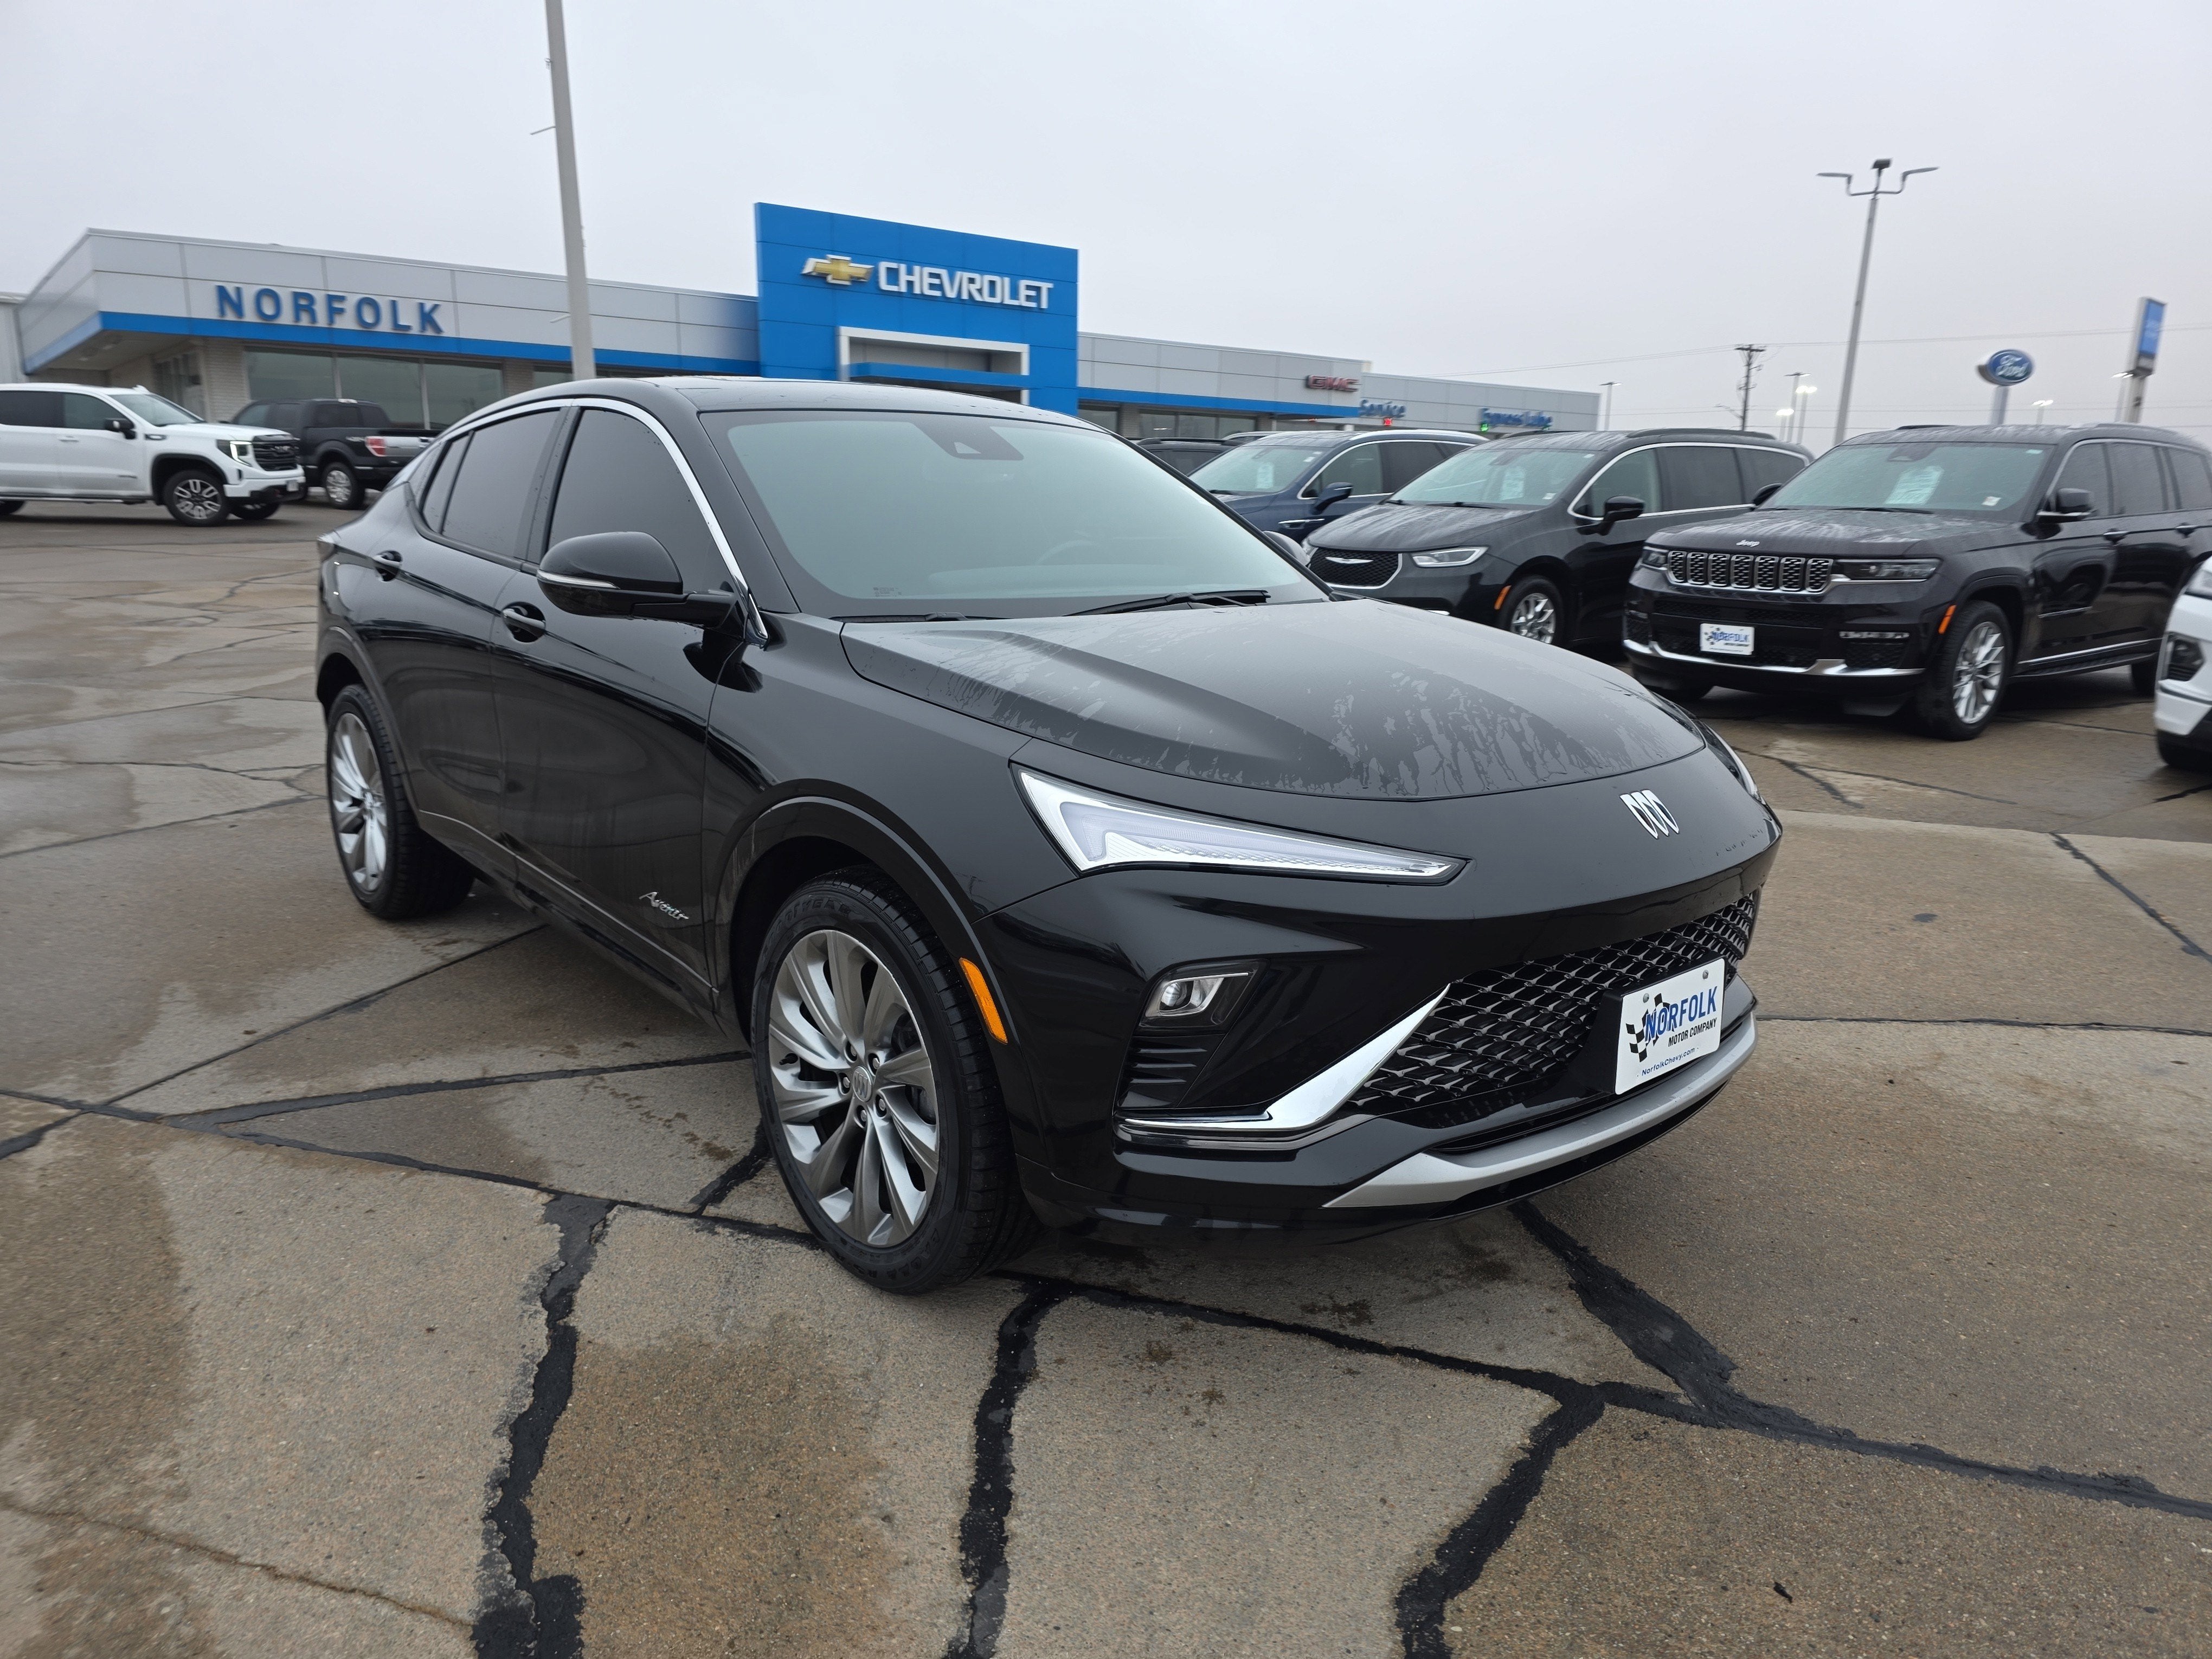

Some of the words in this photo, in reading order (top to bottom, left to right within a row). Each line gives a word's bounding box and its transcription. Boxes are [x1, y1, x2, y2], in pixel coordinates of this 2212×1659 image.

[878, 261, 1053, 309] CHEVROLET
[215, 285, 445, 334] NORFOLK
[1996, 355, 2029, 377] Ford
[1306, 375, 1360, 392] GMC
[1359, 398, 1406, 418] Service
[1711, 632, 1751, 642] NORFOLK
[1645, 986, 1718, 1041] NORFOLK
[1668, 1029, 1688, 1047] MOTOR
[1689, 1018, 1717, 1038] COMPANY
[1642, 1047, 1695, 1076] NorfolkChevy.com
